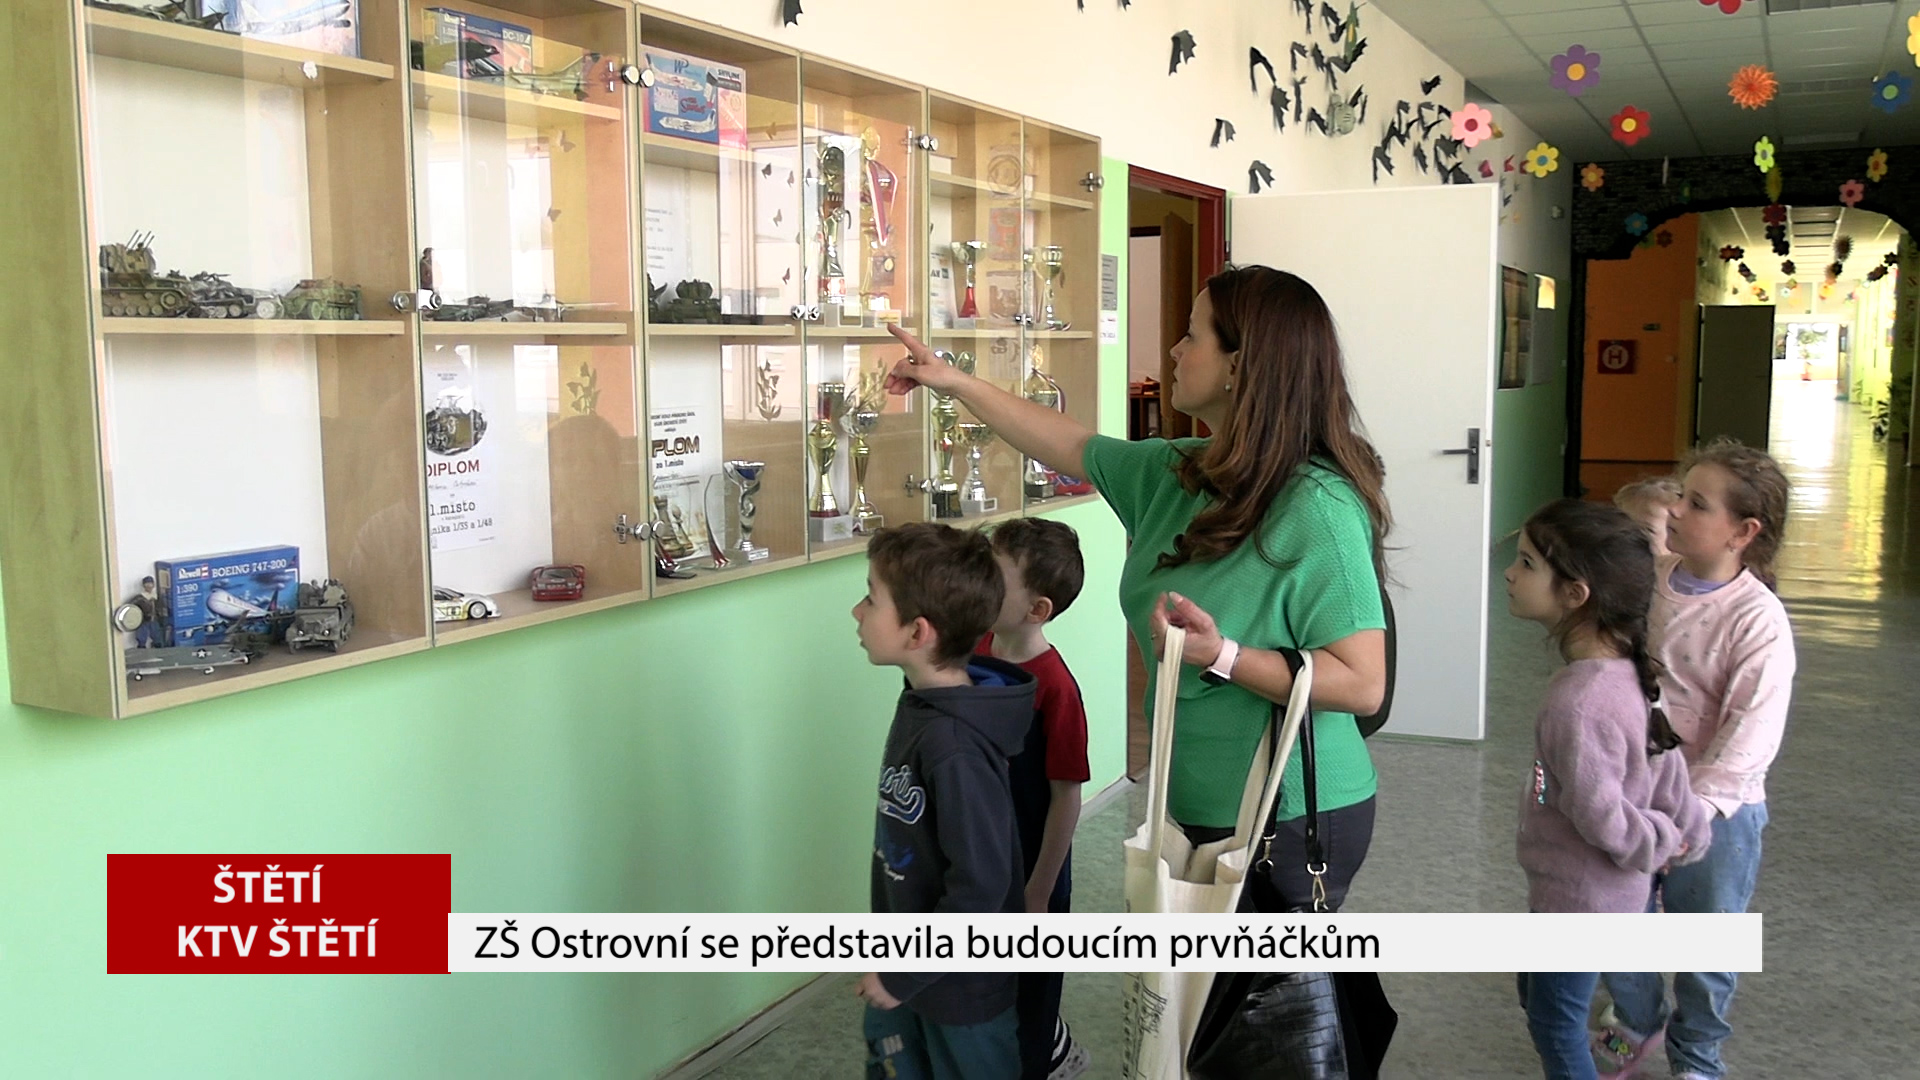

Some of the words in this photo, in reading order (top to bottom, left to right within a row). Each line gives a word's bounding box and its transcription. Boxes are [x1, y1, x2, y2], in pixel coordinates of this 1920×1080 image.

[178, 567, 201, 581] Revell
[211, 564, 250, 578] BOEING
[252, 558, 287, 573] 747-200
